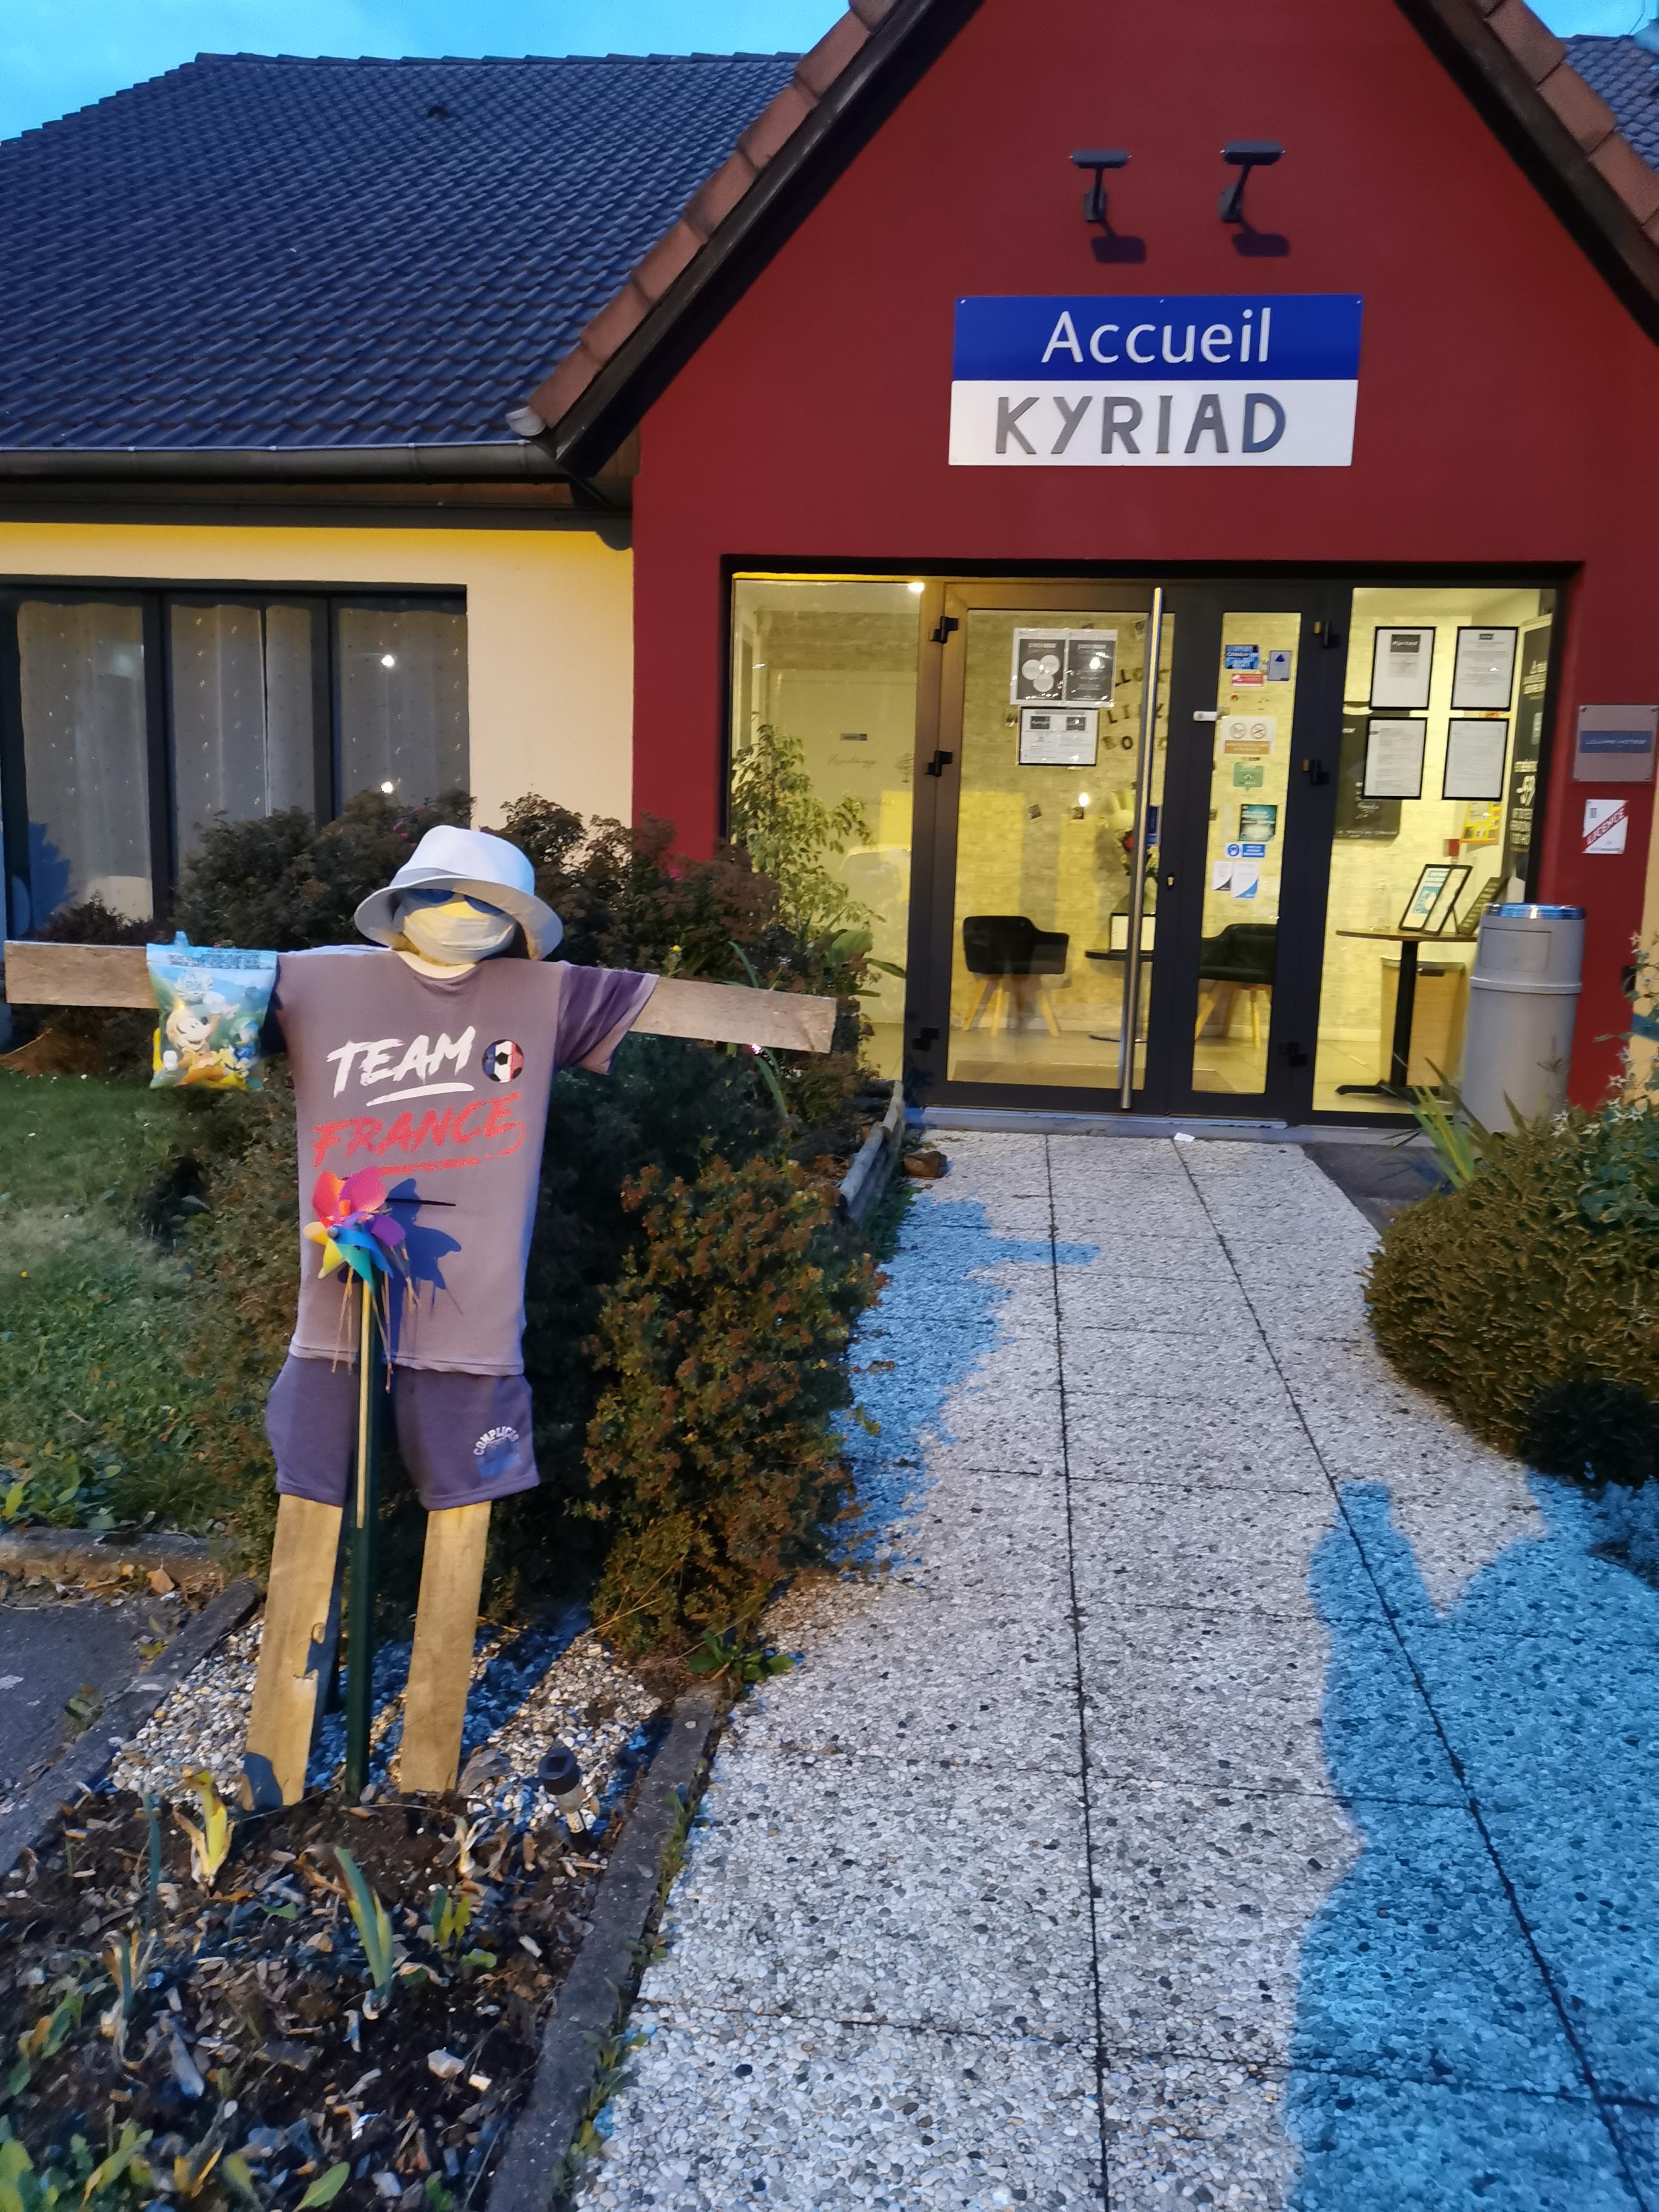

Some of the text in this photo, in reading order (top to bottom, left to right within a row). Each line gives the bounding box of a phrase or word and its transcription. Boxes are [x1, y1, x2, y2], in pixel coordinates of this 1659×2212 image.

[1041, 307, 1271, 363] Accueil
[996, 392, 1286, 454] KYRIAD
[326, 1026, 476, 1098] TEAM
[312, 1092, 523, 1168] FRANCE
